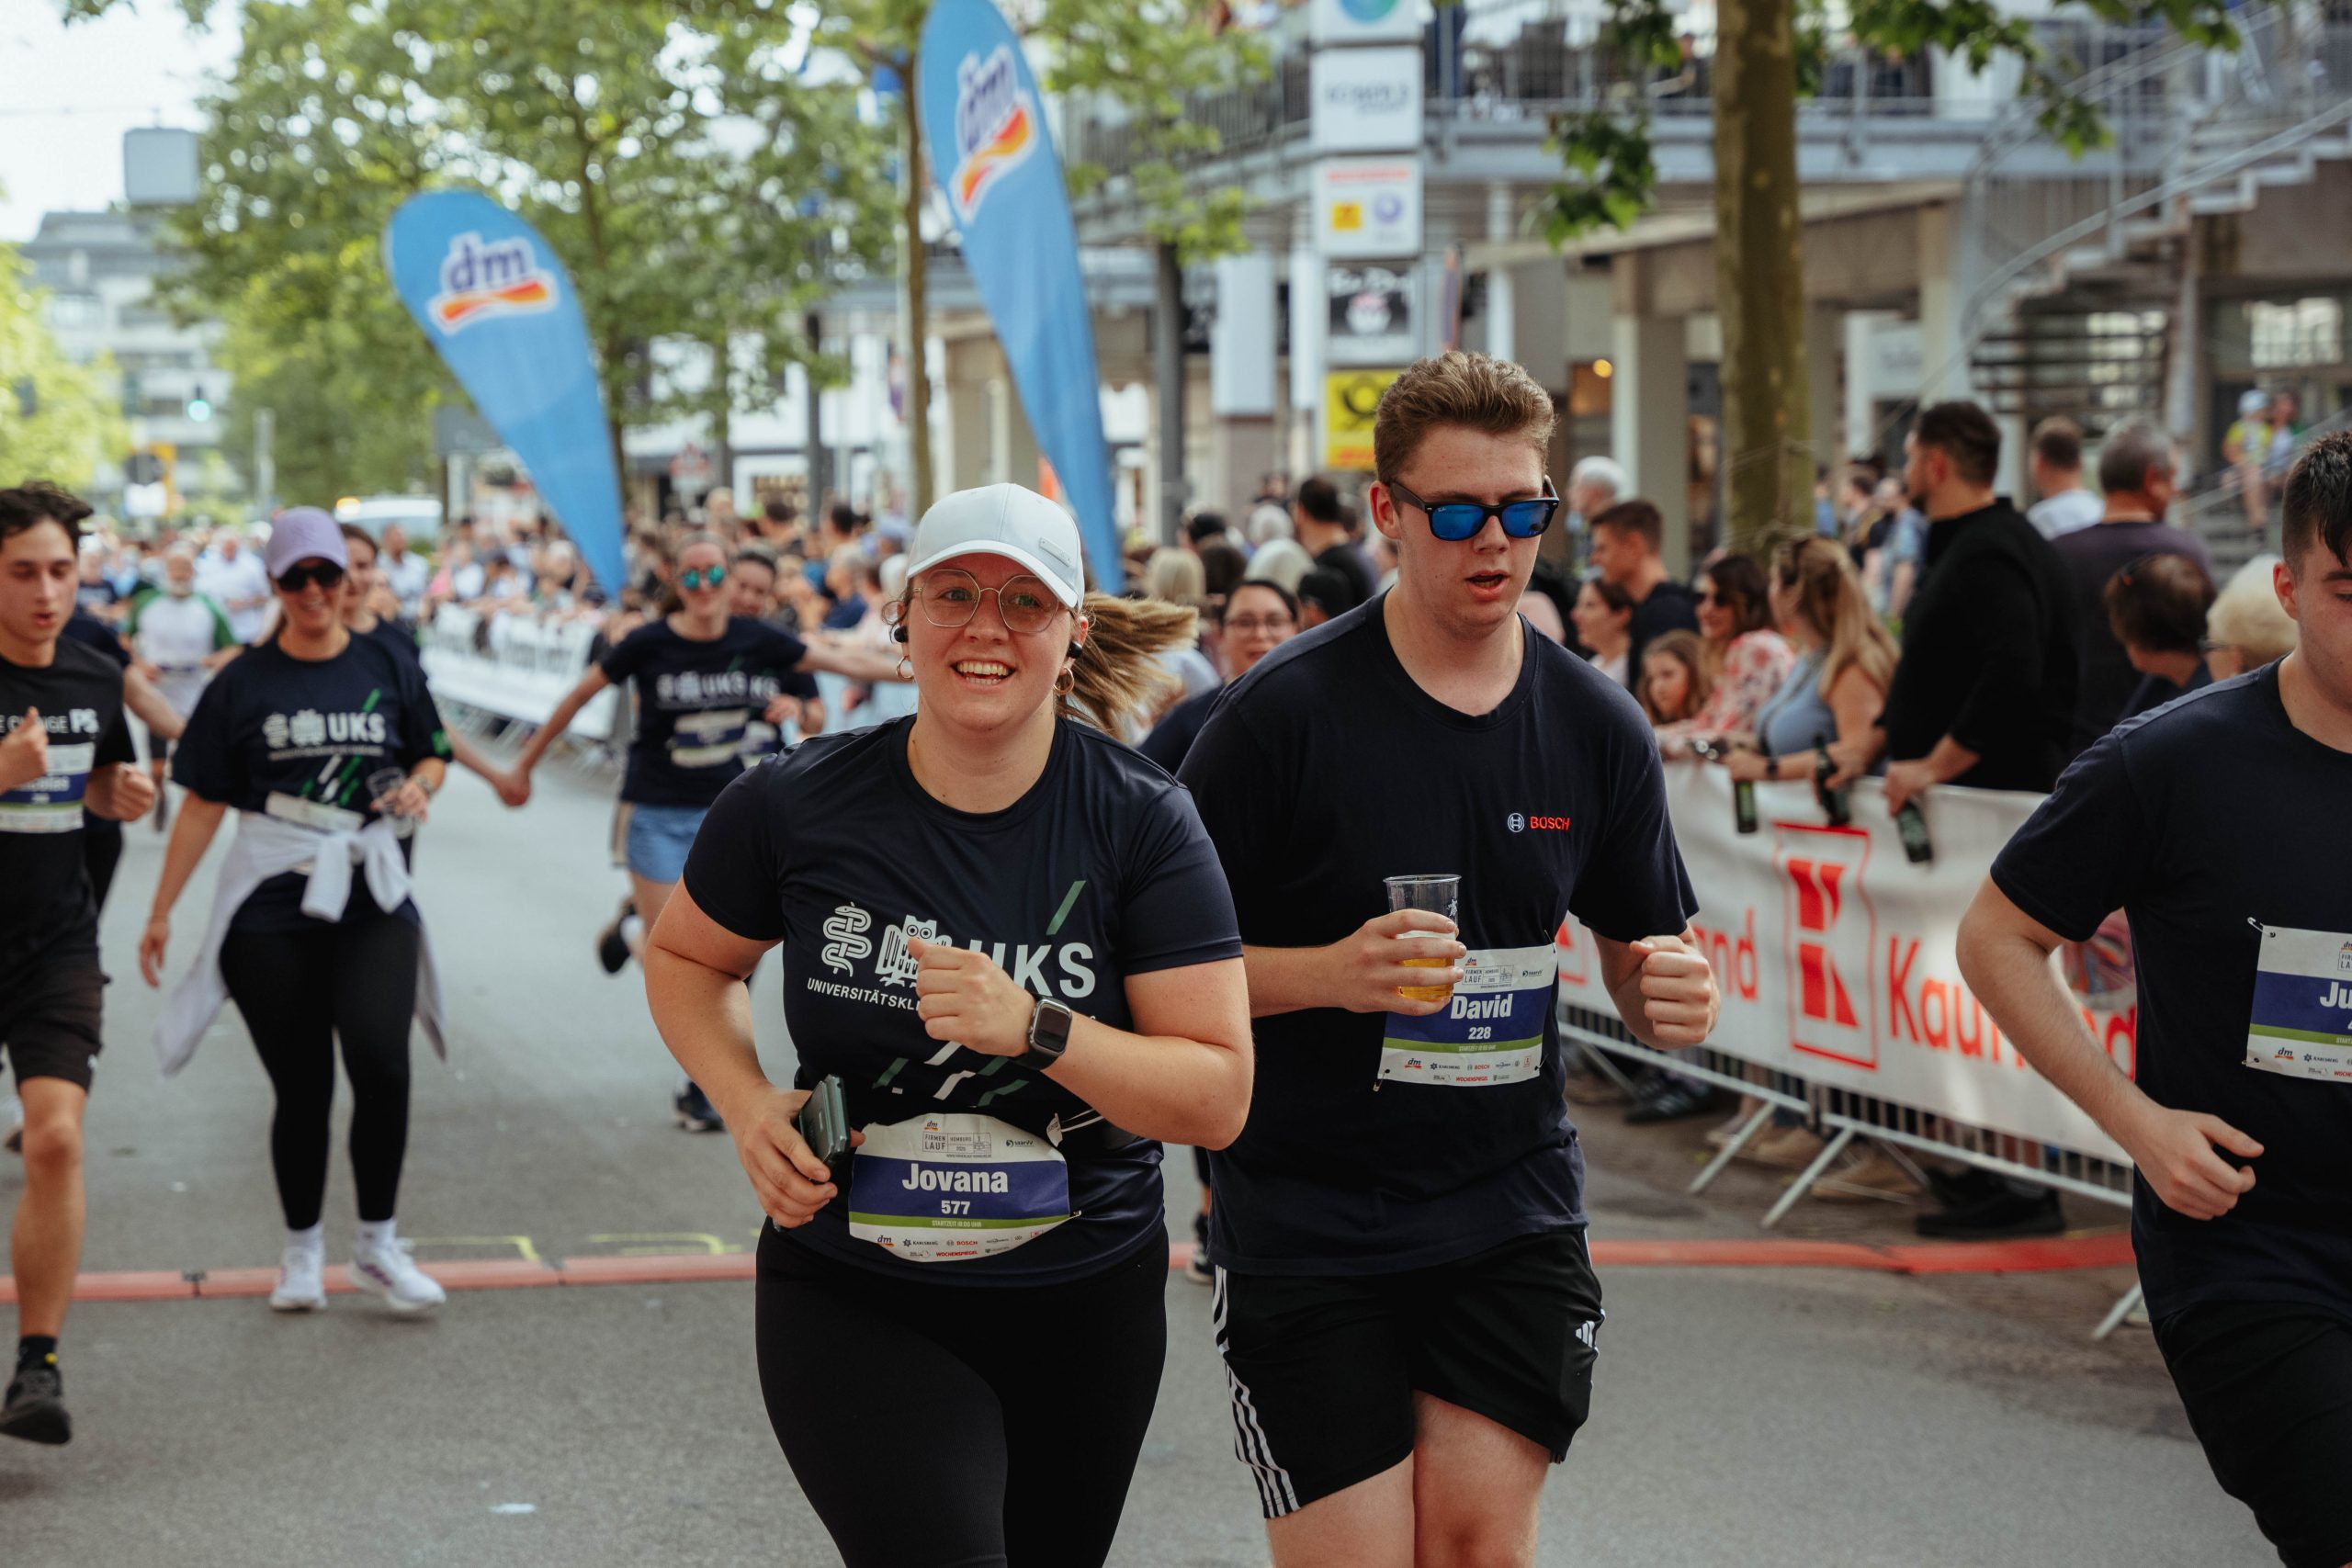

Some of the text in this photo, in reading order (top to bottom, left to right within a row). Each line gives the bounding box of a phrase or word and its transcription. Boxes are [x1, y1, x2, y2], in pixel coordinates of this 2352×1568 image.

[447, 241, 527, 291] dm
[327, 712, 387, 743] UKS
[1530, 816, 1570, 830] BOSCH
[1450, 993, 1513, 1020] David
[1467, 1026, 1492, 1040] 228
[2278, 1047, 2293, 1056] dm
[1408, 1057, 1421, 1066] dm
[924, 1142, 946, 1151] LAUF
[901, 1162, 1009, 1193] Jovana
[941, 1200, 970, 1215] 577
[877, 1235, 892, 1244] dm
